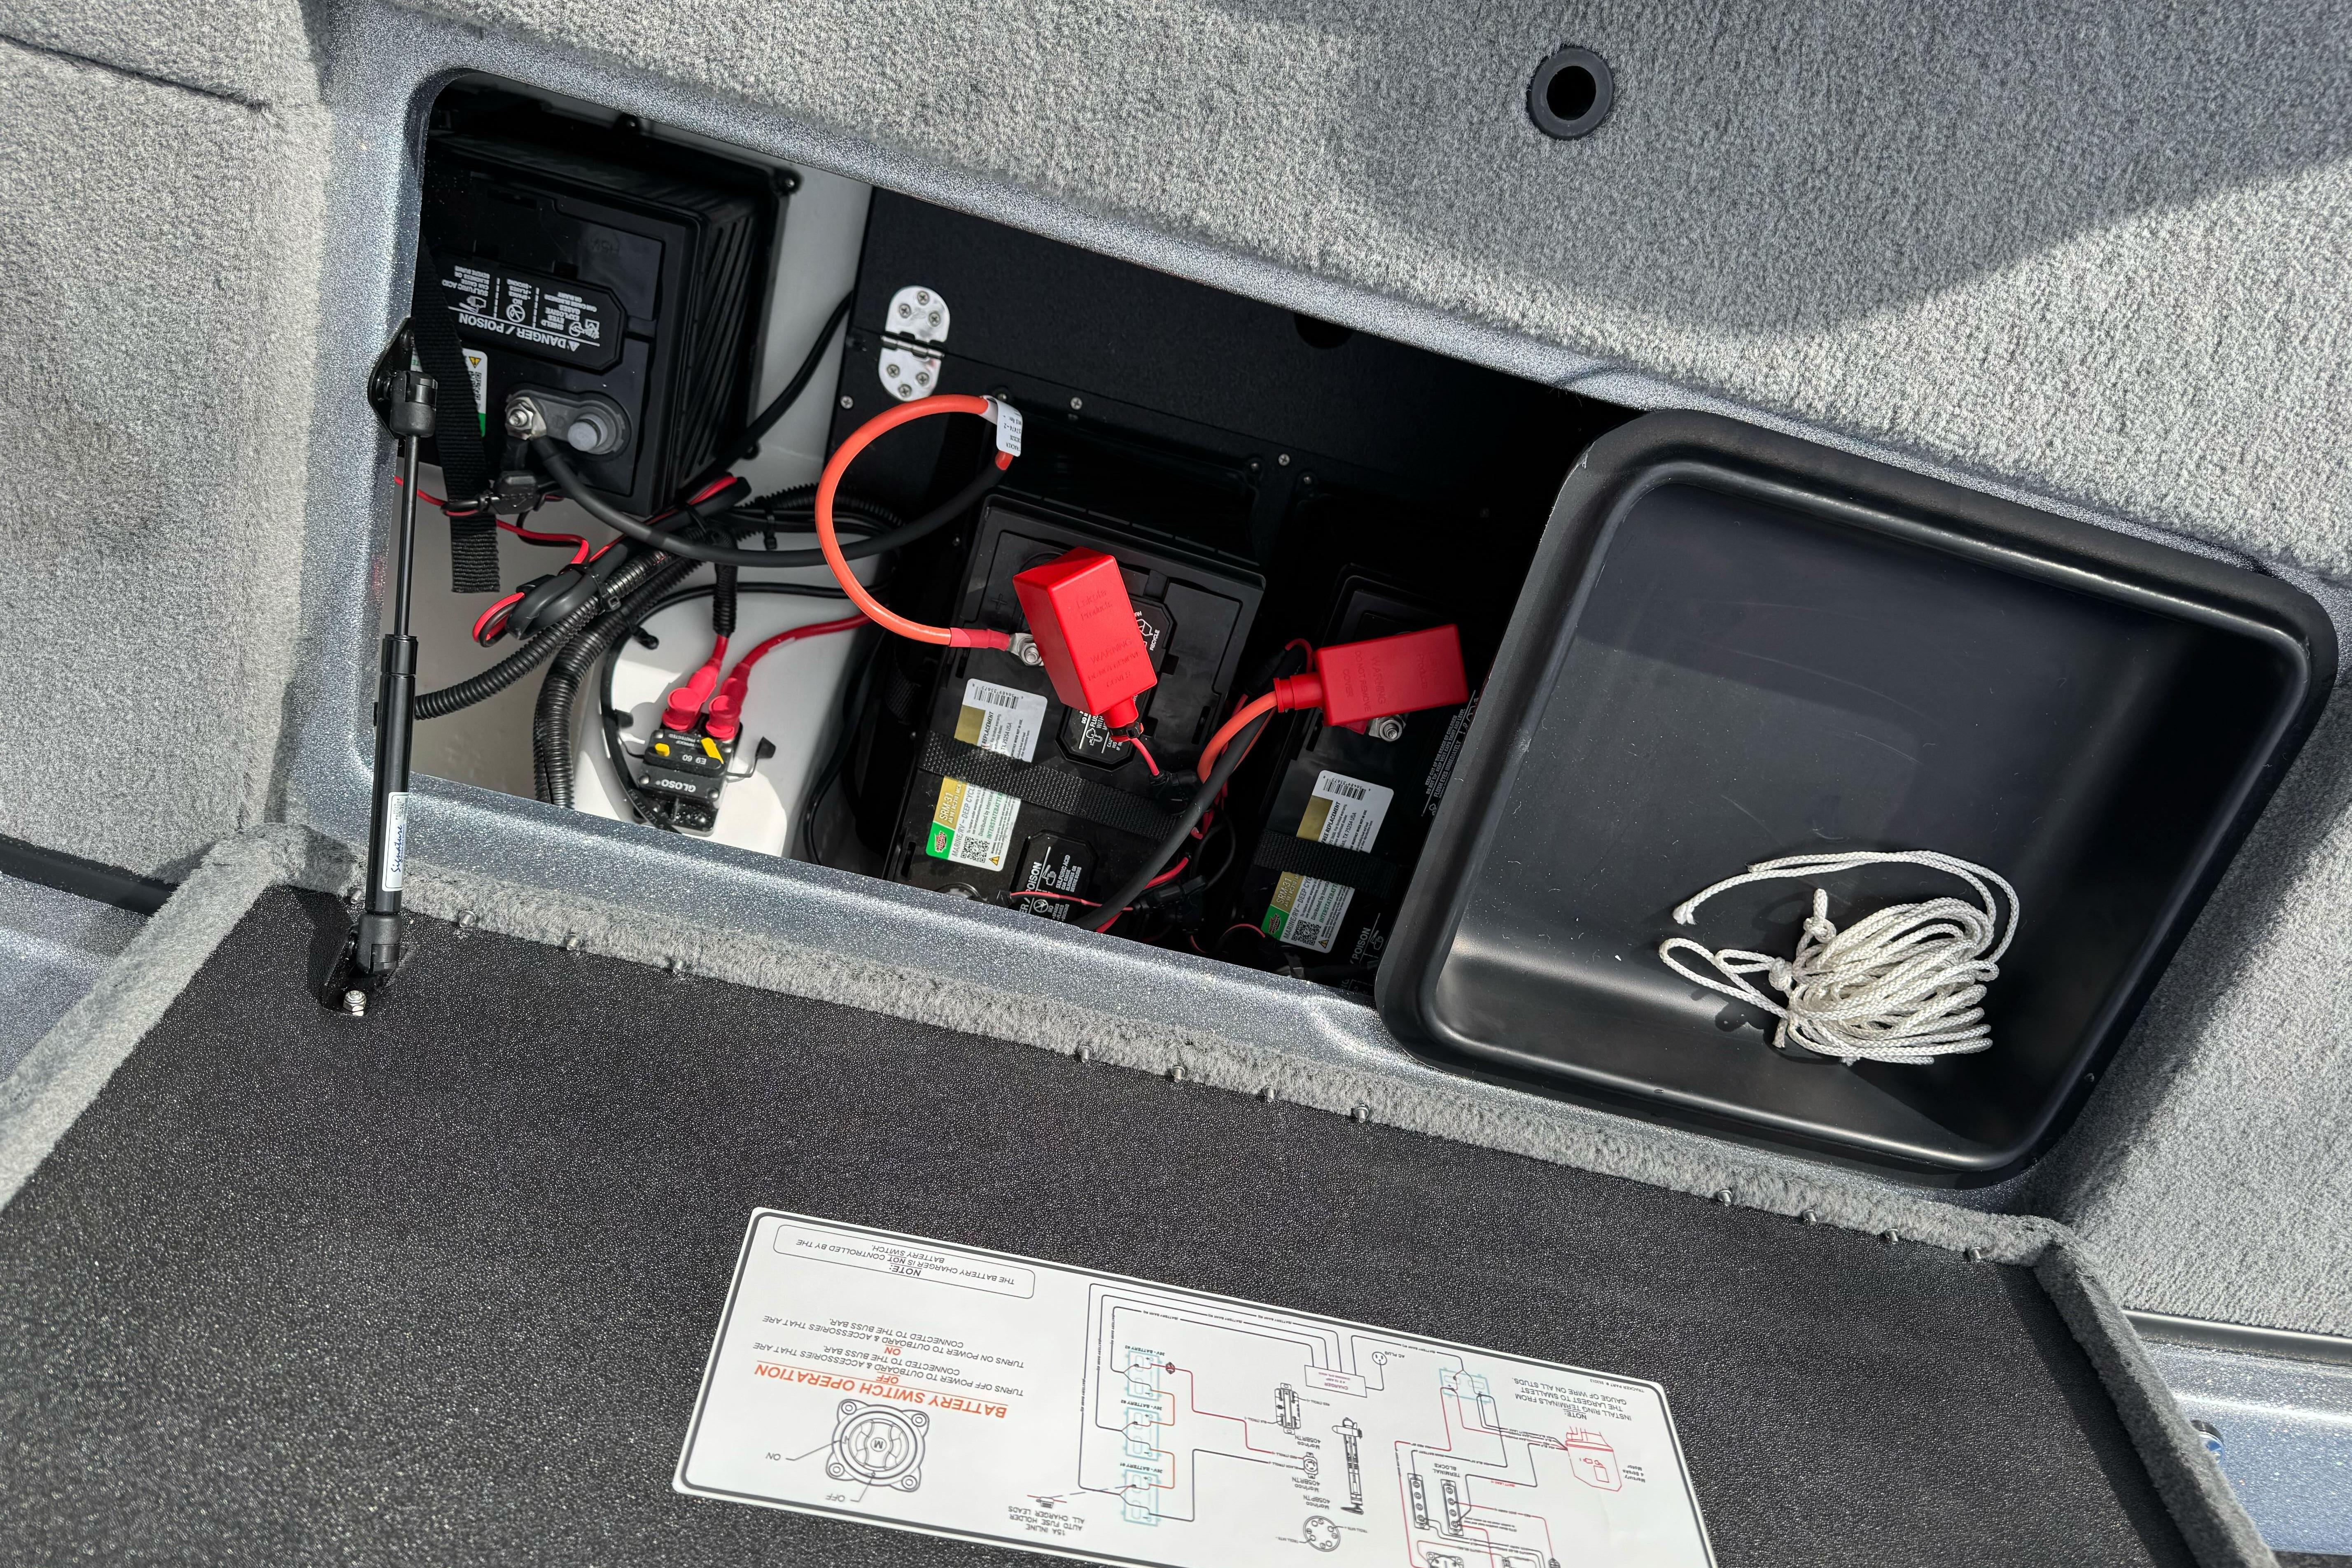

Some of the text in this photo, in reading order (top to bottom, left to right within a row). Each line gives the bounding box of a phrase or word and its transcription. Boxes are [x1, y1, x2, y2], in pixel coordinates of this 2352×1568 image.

[440, 278, 489, 296] SULFURIC ACID
[457, 312, 567, 349] DANGER / POISON
[1149, 629, 1160, 651] RECYCLE
[1090, 637, 1133, 664] WARNING
[981, 711, 994, 744] REPLACEMENT
[1438, 740, 1447, 754] REACH
[681, 754, 707, 765] E9 60
[1433, 740, 1462, 798] FLUSH EYES IMMEDIATELY
[939, 792, 954, 821] SRM-31
[978, 815, 987, 836] Distributed
[985, 791, 994, 810] Interstate
[1325, 801, 1341, 833] REPLACEMENT
[951, 803, 971, 856] MARINE/RV DEEP
[1345, 820, 1353, 833] 75254
[390, 824, 406, 873] Signature
[1055, 854, 1071, 889] SULFURIC ACID
[1276, 877, 1293, 904] SRM-31
[1047, 905, 1054, 913] NO
[1283, 887, 1308, 939] MARINE/RV DEEP
[1351, 926, 1371, 960] POISON
[795, 1239, 813, 1248] THE
[814, 1242, 827, 1250] BY
[828, 1244, 885, 1261] CONTROLLED
[870, 1244, 945, 1264] BATTERY SWITCH.
[886, 1255, 906, 1264] NOT
[888, 1264, 921, 1277] NOTE:
[917, 1260, 958, 1274] CHARGER
[959, 1268, 997, 1281] BATTERY
[998, 1276, 1015, 1285] THE
[761, 1314, 783, 1325] ARE
[782, 1318, 806, 1329] THAT
[808, 1323, 873, 1341] ACCESSORIES
[828, 1318, 964, 1349] CONNECTED TO THE BUSS BAR.
[881, 1336, 931, 1351] OUTBOARD
[931, 1345, 944, 1353] TO
[883, 1345, 901, 1356] ON
[945, 1348, 979, 1360] POWER
[822, 1345, 960, 1376] CONNECTED TO THE BUSS BAR.
[980, 1354, 994, 1363] ON
[994, 1356, 1024, 1368] TURNS
[752, 1341, 1024, 1397] TURNS OFF POWER TO OUTBOARD & ACCESSORIES THAT ARE
[875, 1373, 899, 1384] OFF
[1511, 1377, 1539, 1388] STUDS.
[754, 1363, 1007, 1419] BATTERY SWITCH OPERATION
[1520, 1386, 1558, 1400] SMALLEST
[1567, 1388, 1587, 1398] WIRE
[1572, 1396, 1606, 1409] LARGEST
[1600, 1394, 1626, 1405] GAUGE
[1514, 1393, 1632, 1421] INSTALL RING TERMINALS FROM
[1607, 1403, 1623, 1412] THE
[1562, 1409, 1587, 1420] NOTE:
[765, 1451, 781, 1461] ON
[1432, 1468, 1461, 1478] TERMINAL
[1433, 1462, 1457, 1471] BLOCKS
[825, 1492, 845, 1503] OFF
[1007, 1505, 1031, 1515] LEADS
[1034, 1510, 1068, 1521] CHARGER
[1009, 1513, 1082, 1531] AUTO FUSE HOLDER
[1025, 1523, 1048, 1533] INLINE
